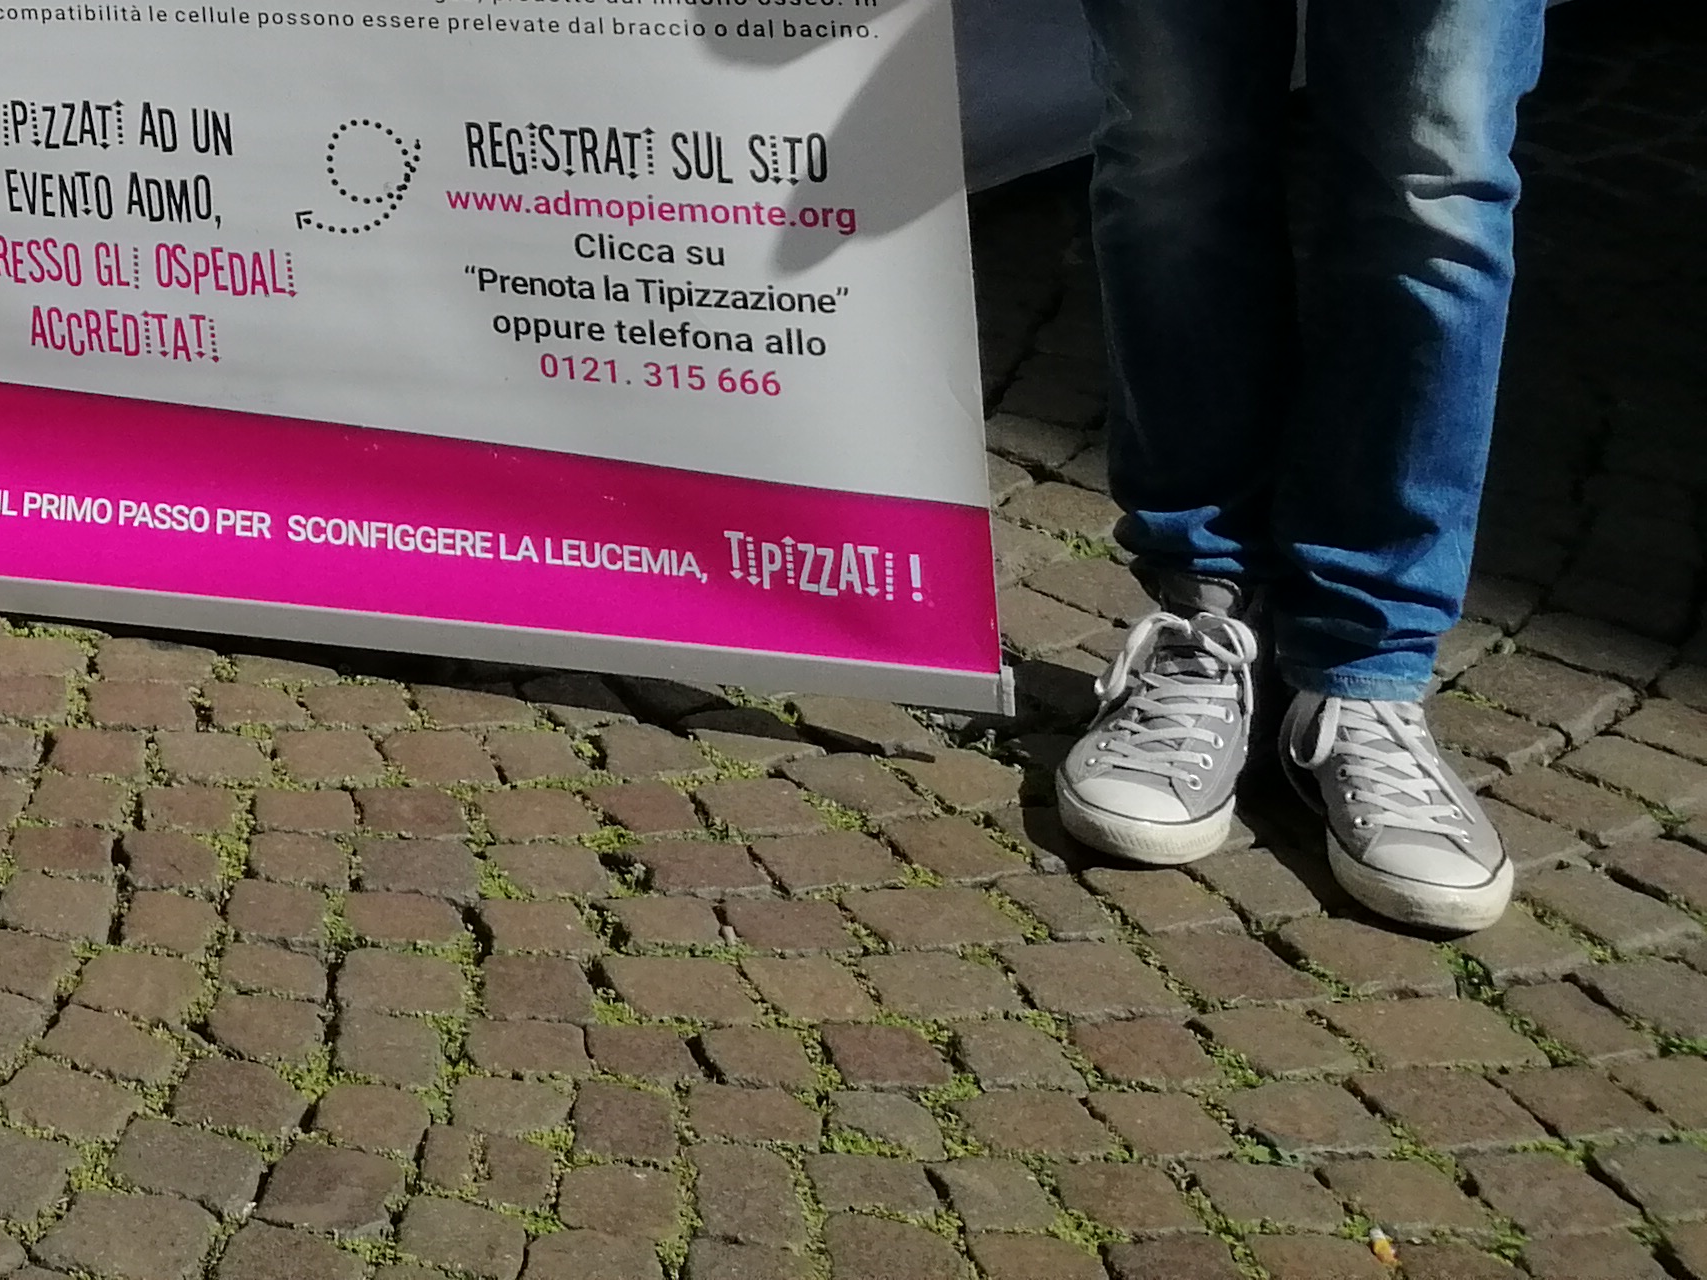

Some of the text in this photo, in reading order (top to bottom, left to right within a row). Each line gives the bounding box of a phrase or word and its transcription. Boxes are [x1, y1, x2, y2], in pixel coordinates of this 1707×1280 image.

[175, 6, 250, 24] cellule
[258, 12, 354, 28] possono
[448, 13, 560, 34] prelevate
[612, 17, 705, 36] braccio
[782, 18, 879, 39] bacino.
[139, 102, 177, 152] AD
[191, 108, 233, 156] UN
[465, 121, 828, 186] REGISTRATI SUL SITO
[5, 169, 221, 230] EVENTO ADMO,
[446, 190, 856, 236] www.admopiemonte.org
[95, 242, 139, 289] GLI
[155, 243, 298, 298] OSPEDALI
[575, 233, 725, 266] Clicca su
[603, 275, 629, 302] la
[31, 305, 219, 363] ACCREDITATI
[493, 315, 826, 356] oppure telefona allo
[540, 353, 781, 396] 0121. 315 666
[23, 492, 115, 524] PRIMO
[118, 500, 214, 533] PASSO
[216, 508, 272, 539] PER
[287, 515, 494, 559] SCONFIGGERE
[499, 533, 539, 563] LA
[545, 537, 708, 584] LEUCEMIA,
[724, 531, 894, 601] TIPIZZATI
